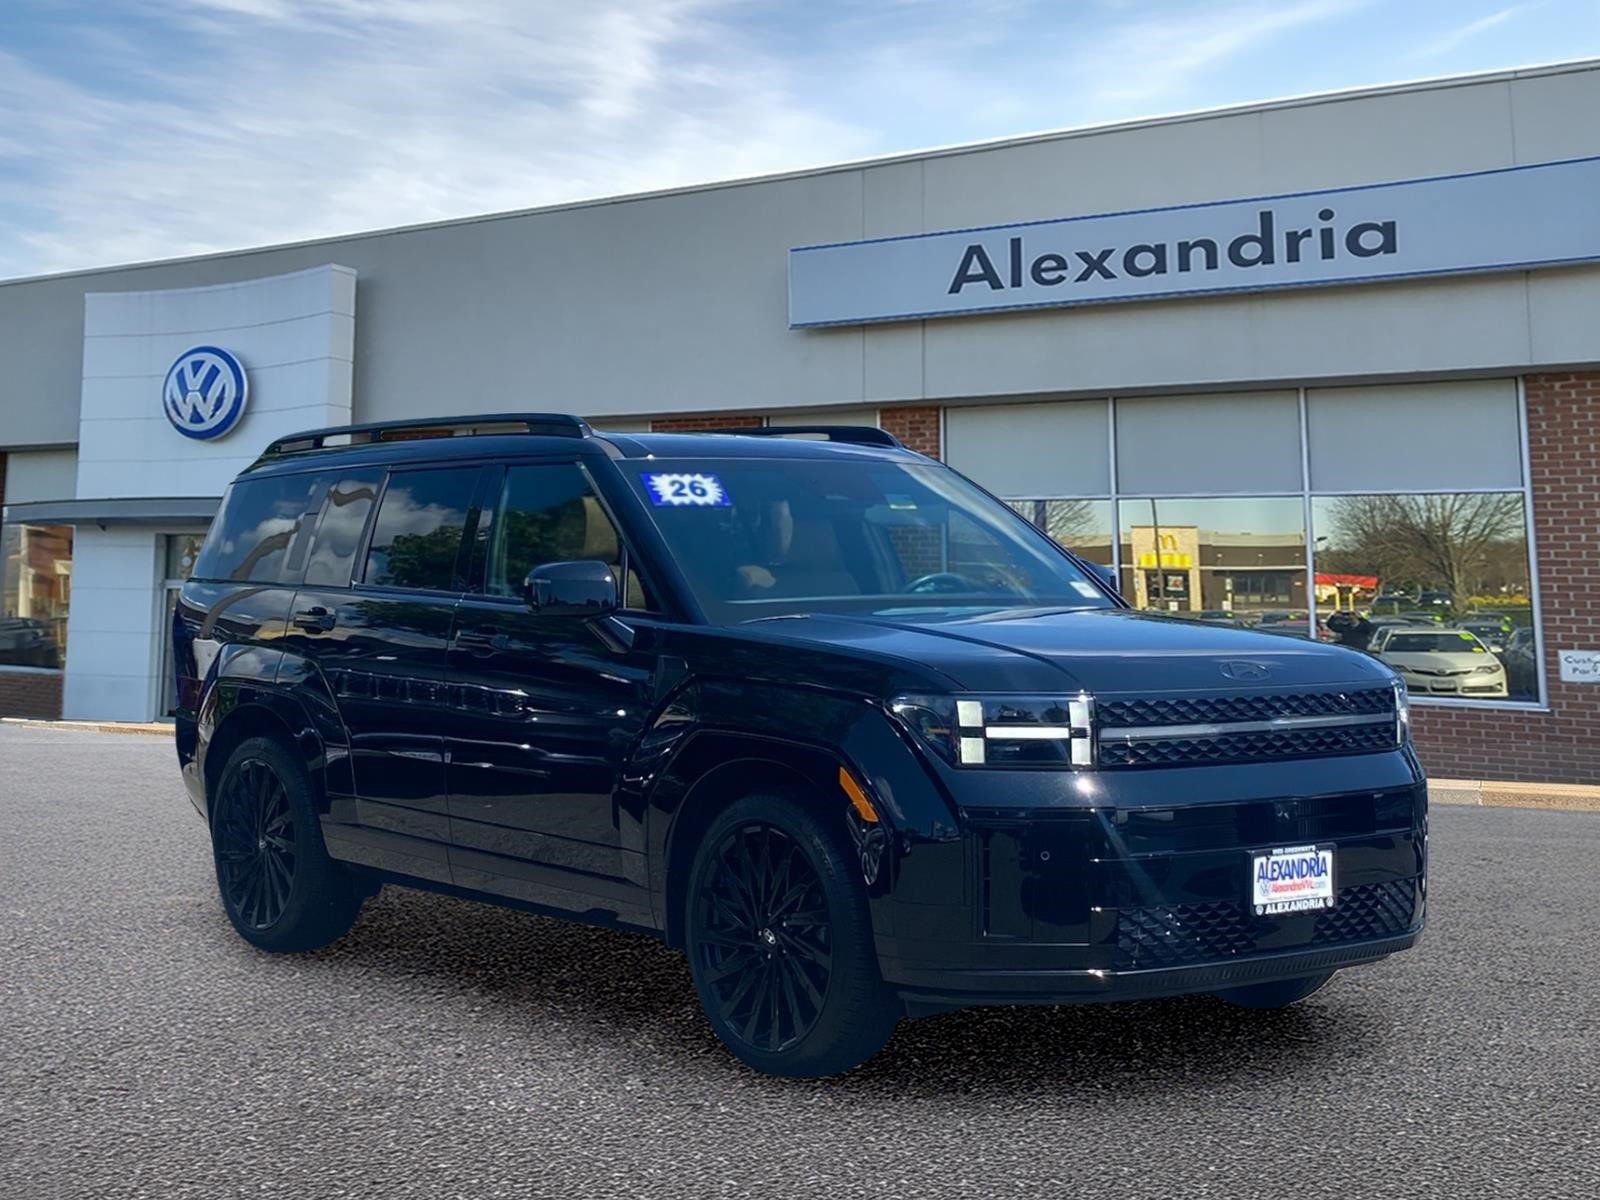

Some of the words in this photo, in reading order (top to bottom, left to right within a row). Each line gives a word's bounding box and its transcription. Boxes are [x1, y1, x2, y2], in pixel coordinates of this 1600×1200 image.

[948, 208, 1398, 294] Alexandria
[669, 479, 708, 497] 26
[1257, 856, 1328, 883] ALEXANDRIA
[1265, 898, 1325, 914] ALEXANDRIA
